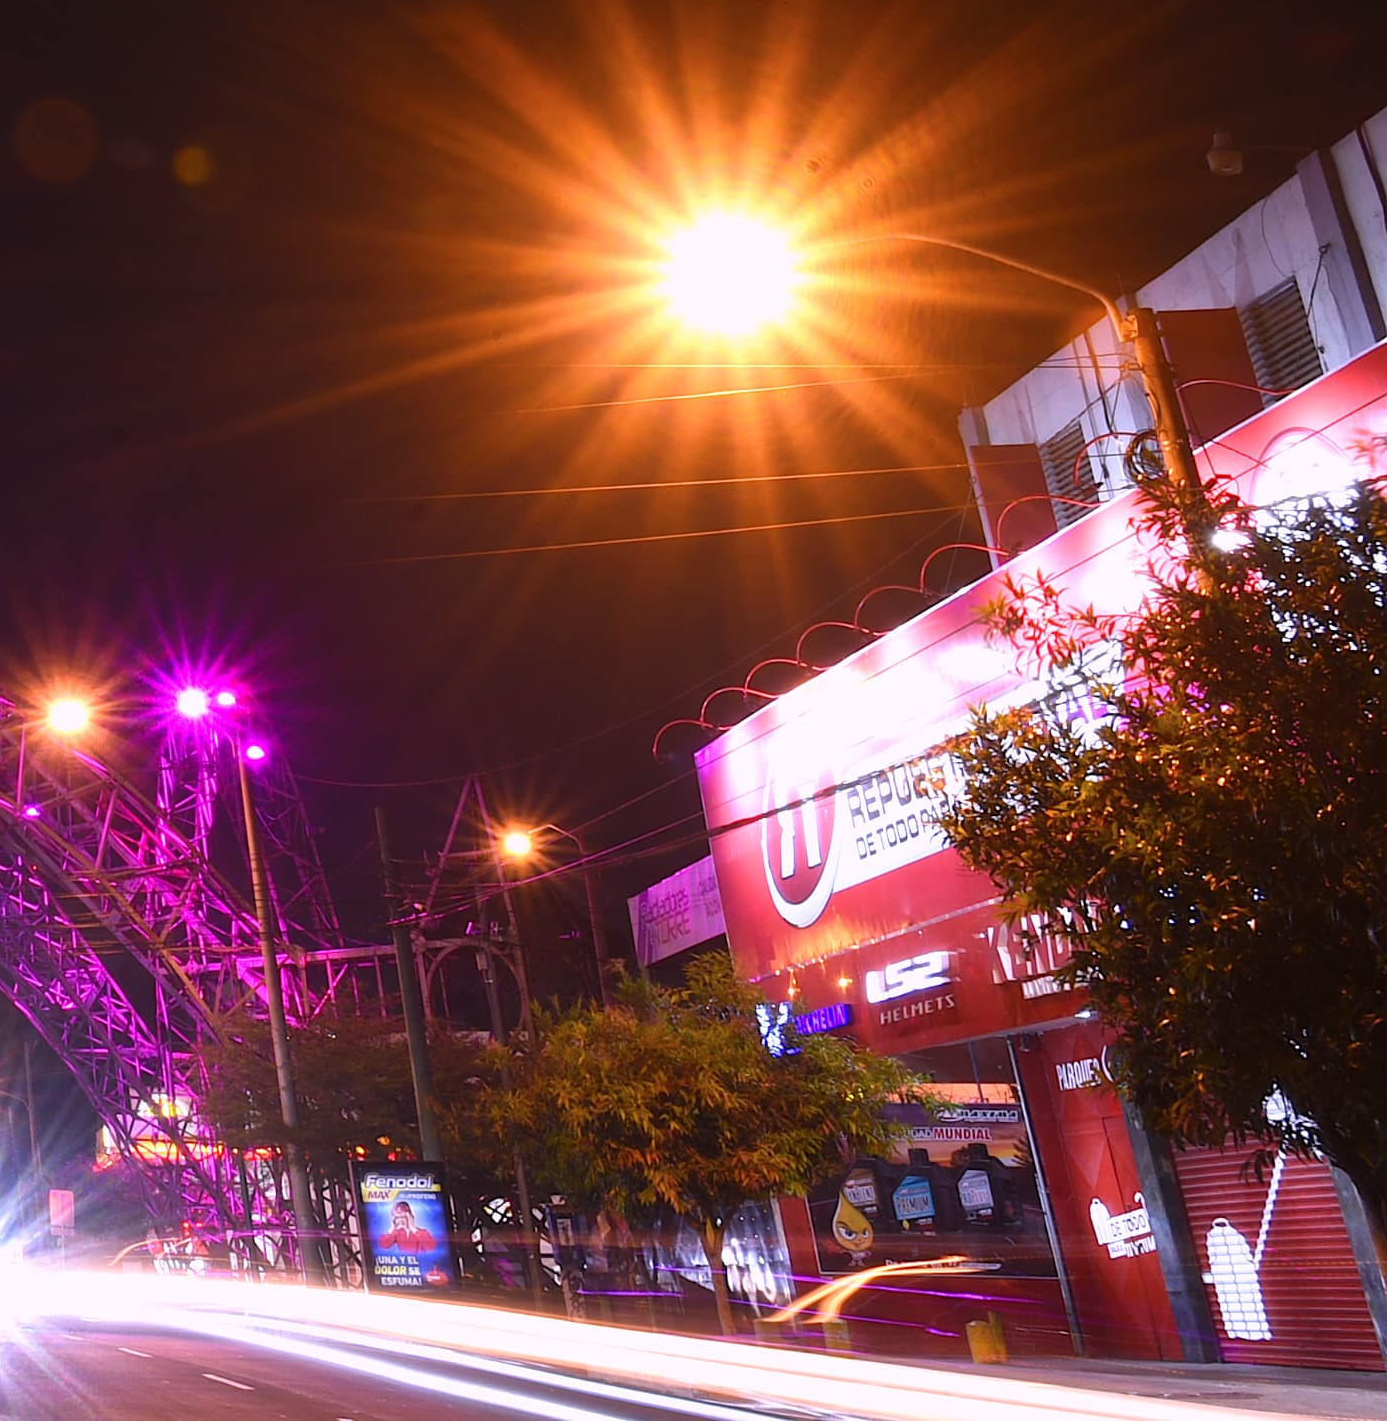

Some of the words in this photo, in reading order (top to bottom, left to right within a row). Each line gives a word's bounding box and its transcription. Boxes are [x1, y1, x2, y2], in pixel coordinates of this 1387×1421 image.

[856, 832, 877, 860] DE
[876, 813, 920, 851] TODO
[866, 951, 951, 1004] LS2
[880, 994, 955, 1025] HELMETS
[933, 1128, 992, 1141] MUNDIAL
[365, 1174, 433, 1189] Fenodol
[367, 1191, 390, 1200] MAX
[399, 1256, 406, 1264] Y
[408, 1256, 419, 1264] EL
[374, 1265, 407, 1275] DOLOR
[408, 1265, 421, 1275] SE
[381, 1276, 423, 1286] ESFUMA!
